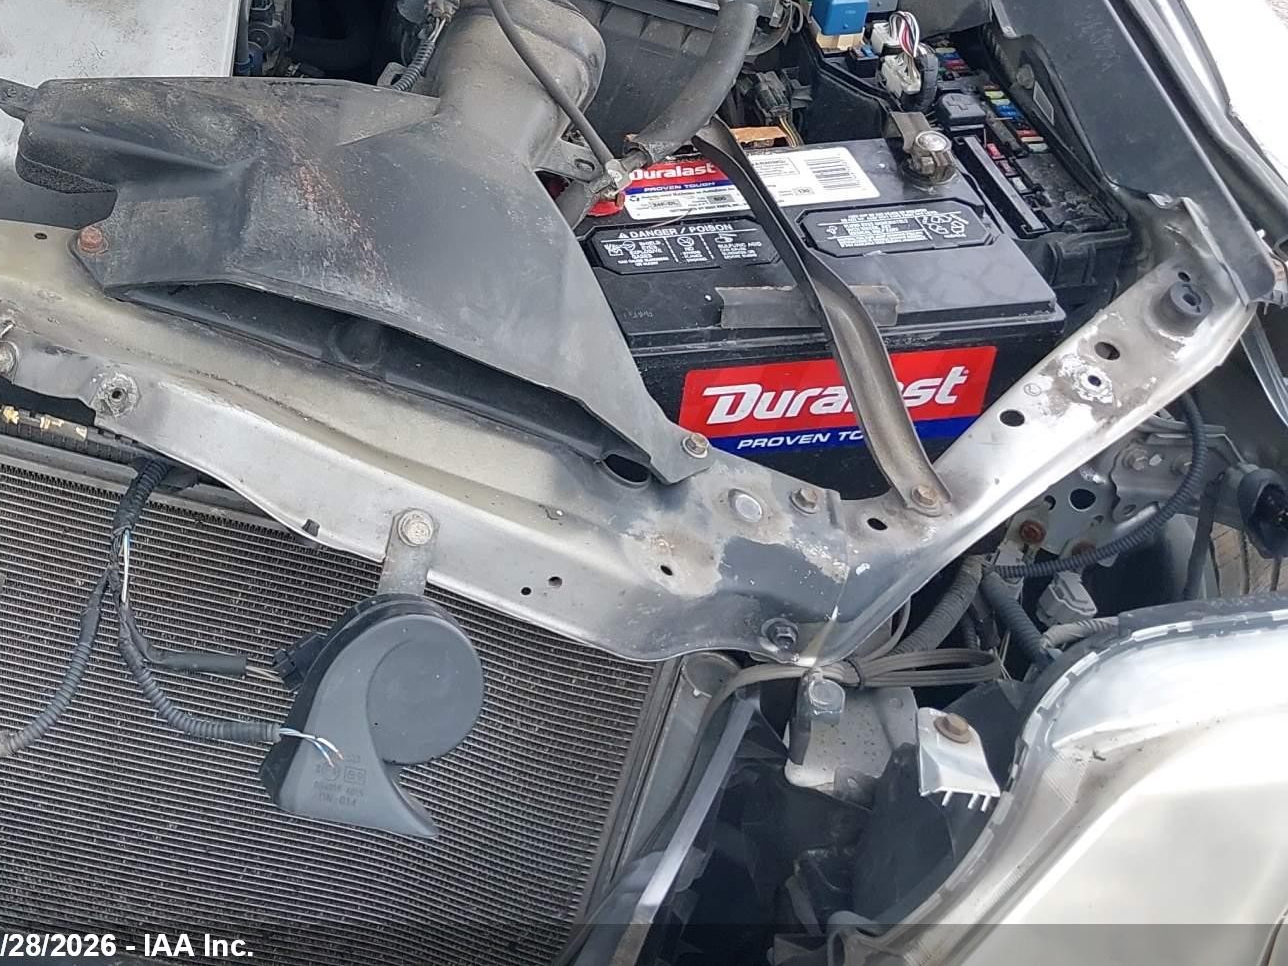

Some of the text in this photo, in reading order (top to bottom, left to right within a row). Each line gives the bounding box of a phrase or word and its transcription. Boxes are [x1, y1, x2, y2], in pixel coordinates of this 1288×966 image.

[643, 184, 682, 193] PROVEN
[684, 181, 716, 190] TOUGH
[629, 227, 678, 239] DANGER
[688, 224, 734, 233] POISON
[702, 366, 969, 425] Durast
[737, 433, 831, 450] PROVEN
